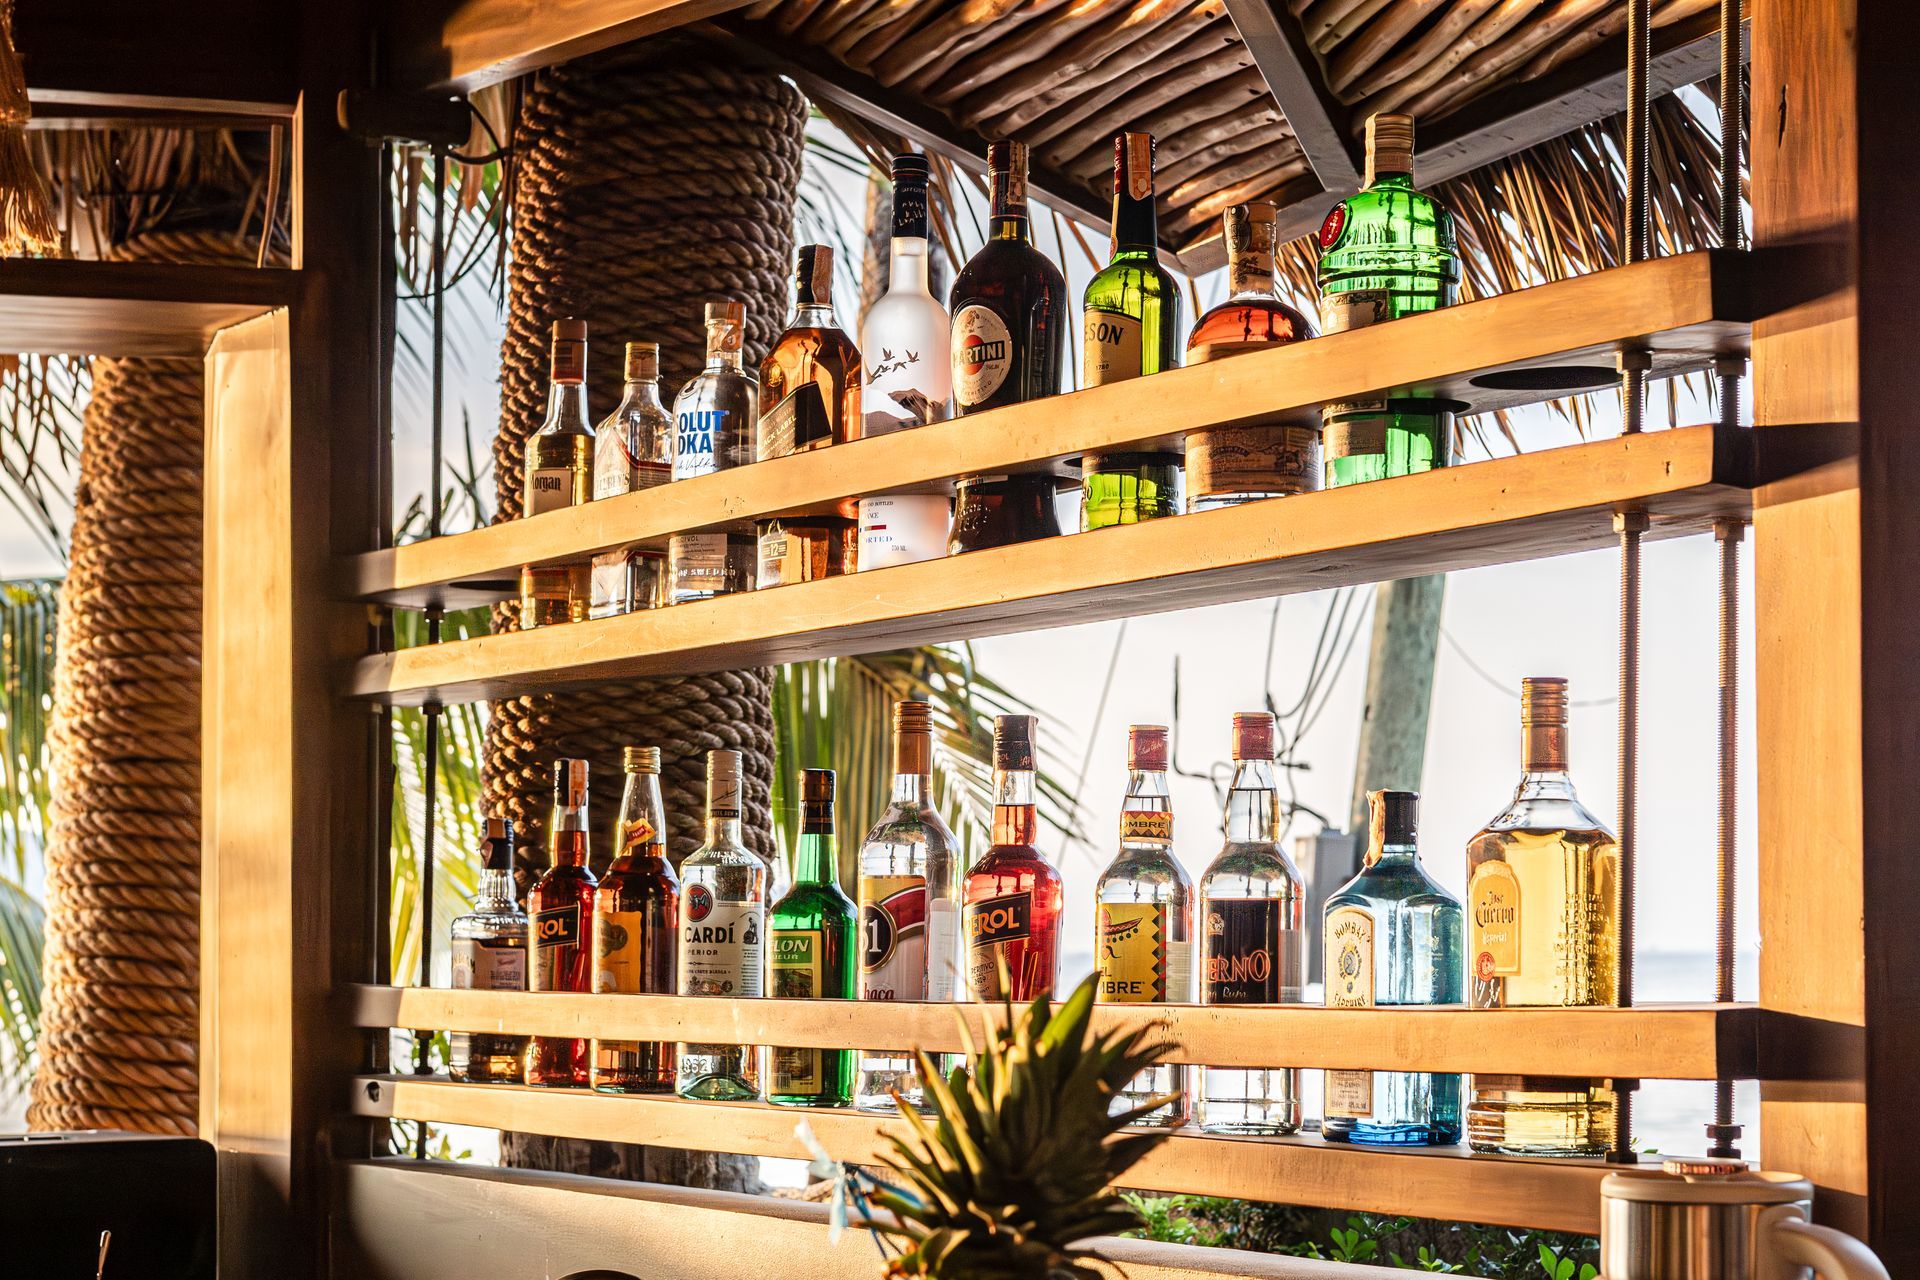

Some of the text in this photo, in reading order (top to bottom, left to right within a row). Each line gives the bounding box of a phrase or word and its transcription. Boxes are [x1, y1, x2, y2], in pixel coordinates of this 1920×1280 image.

[1475, 901, 1514, 928] Cuervo
[685, 921, 735, 944] CARDÍ
[1334, 921, 1366, 940] BOMBAY
[1102, 981, 1142, 995] BRE
